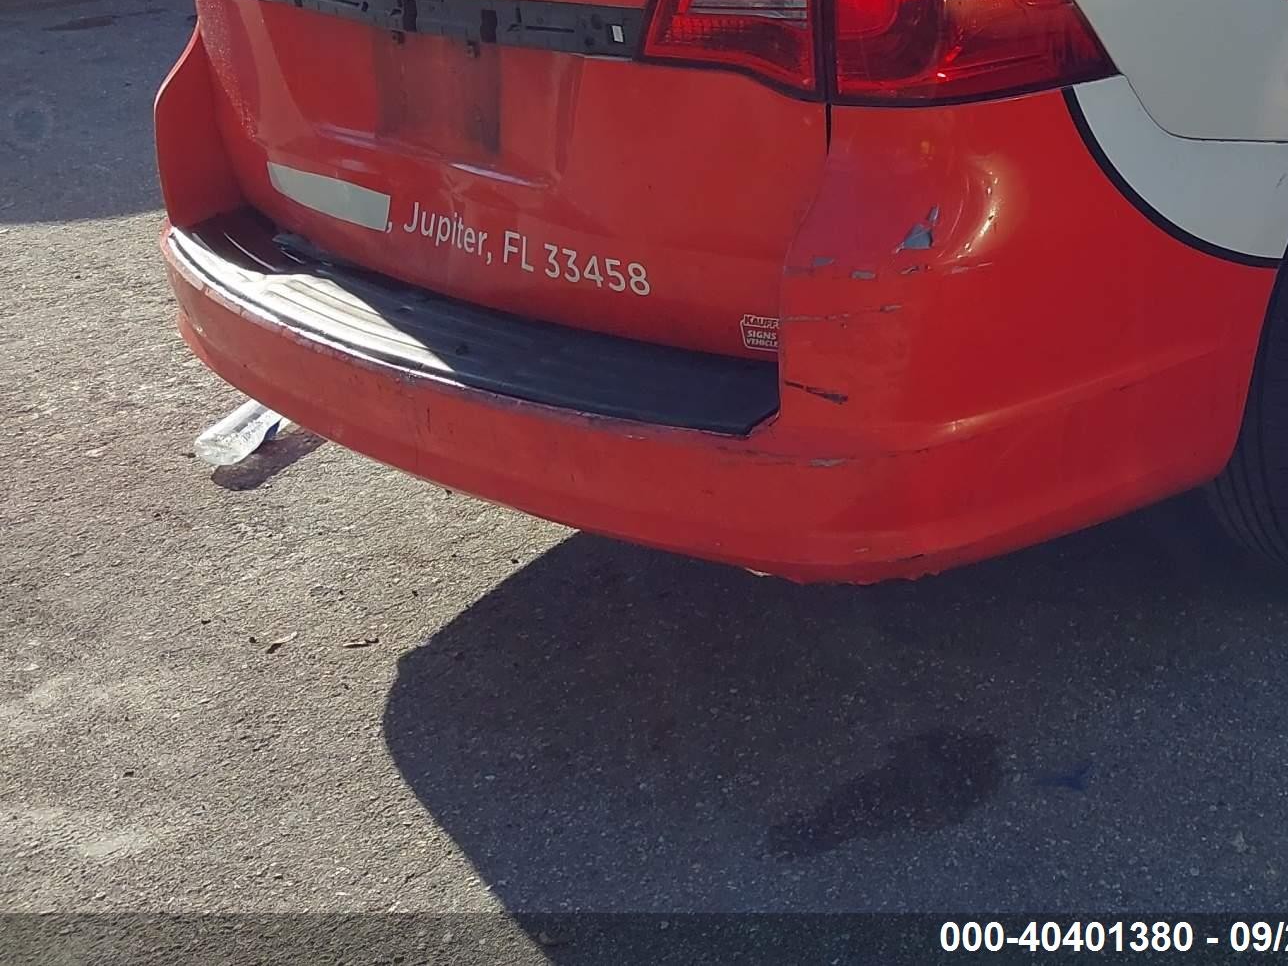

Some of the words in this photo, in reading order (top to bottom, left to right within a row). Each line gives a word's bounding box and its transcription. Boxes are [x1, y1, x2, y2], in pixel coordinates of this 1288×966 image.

[403, 201, 493, 266] Jupiter,
[503, 230, 535, 273] FL
[543, 243, 651, 296] 33458
[747, 329, 777, 340] SIGNS
